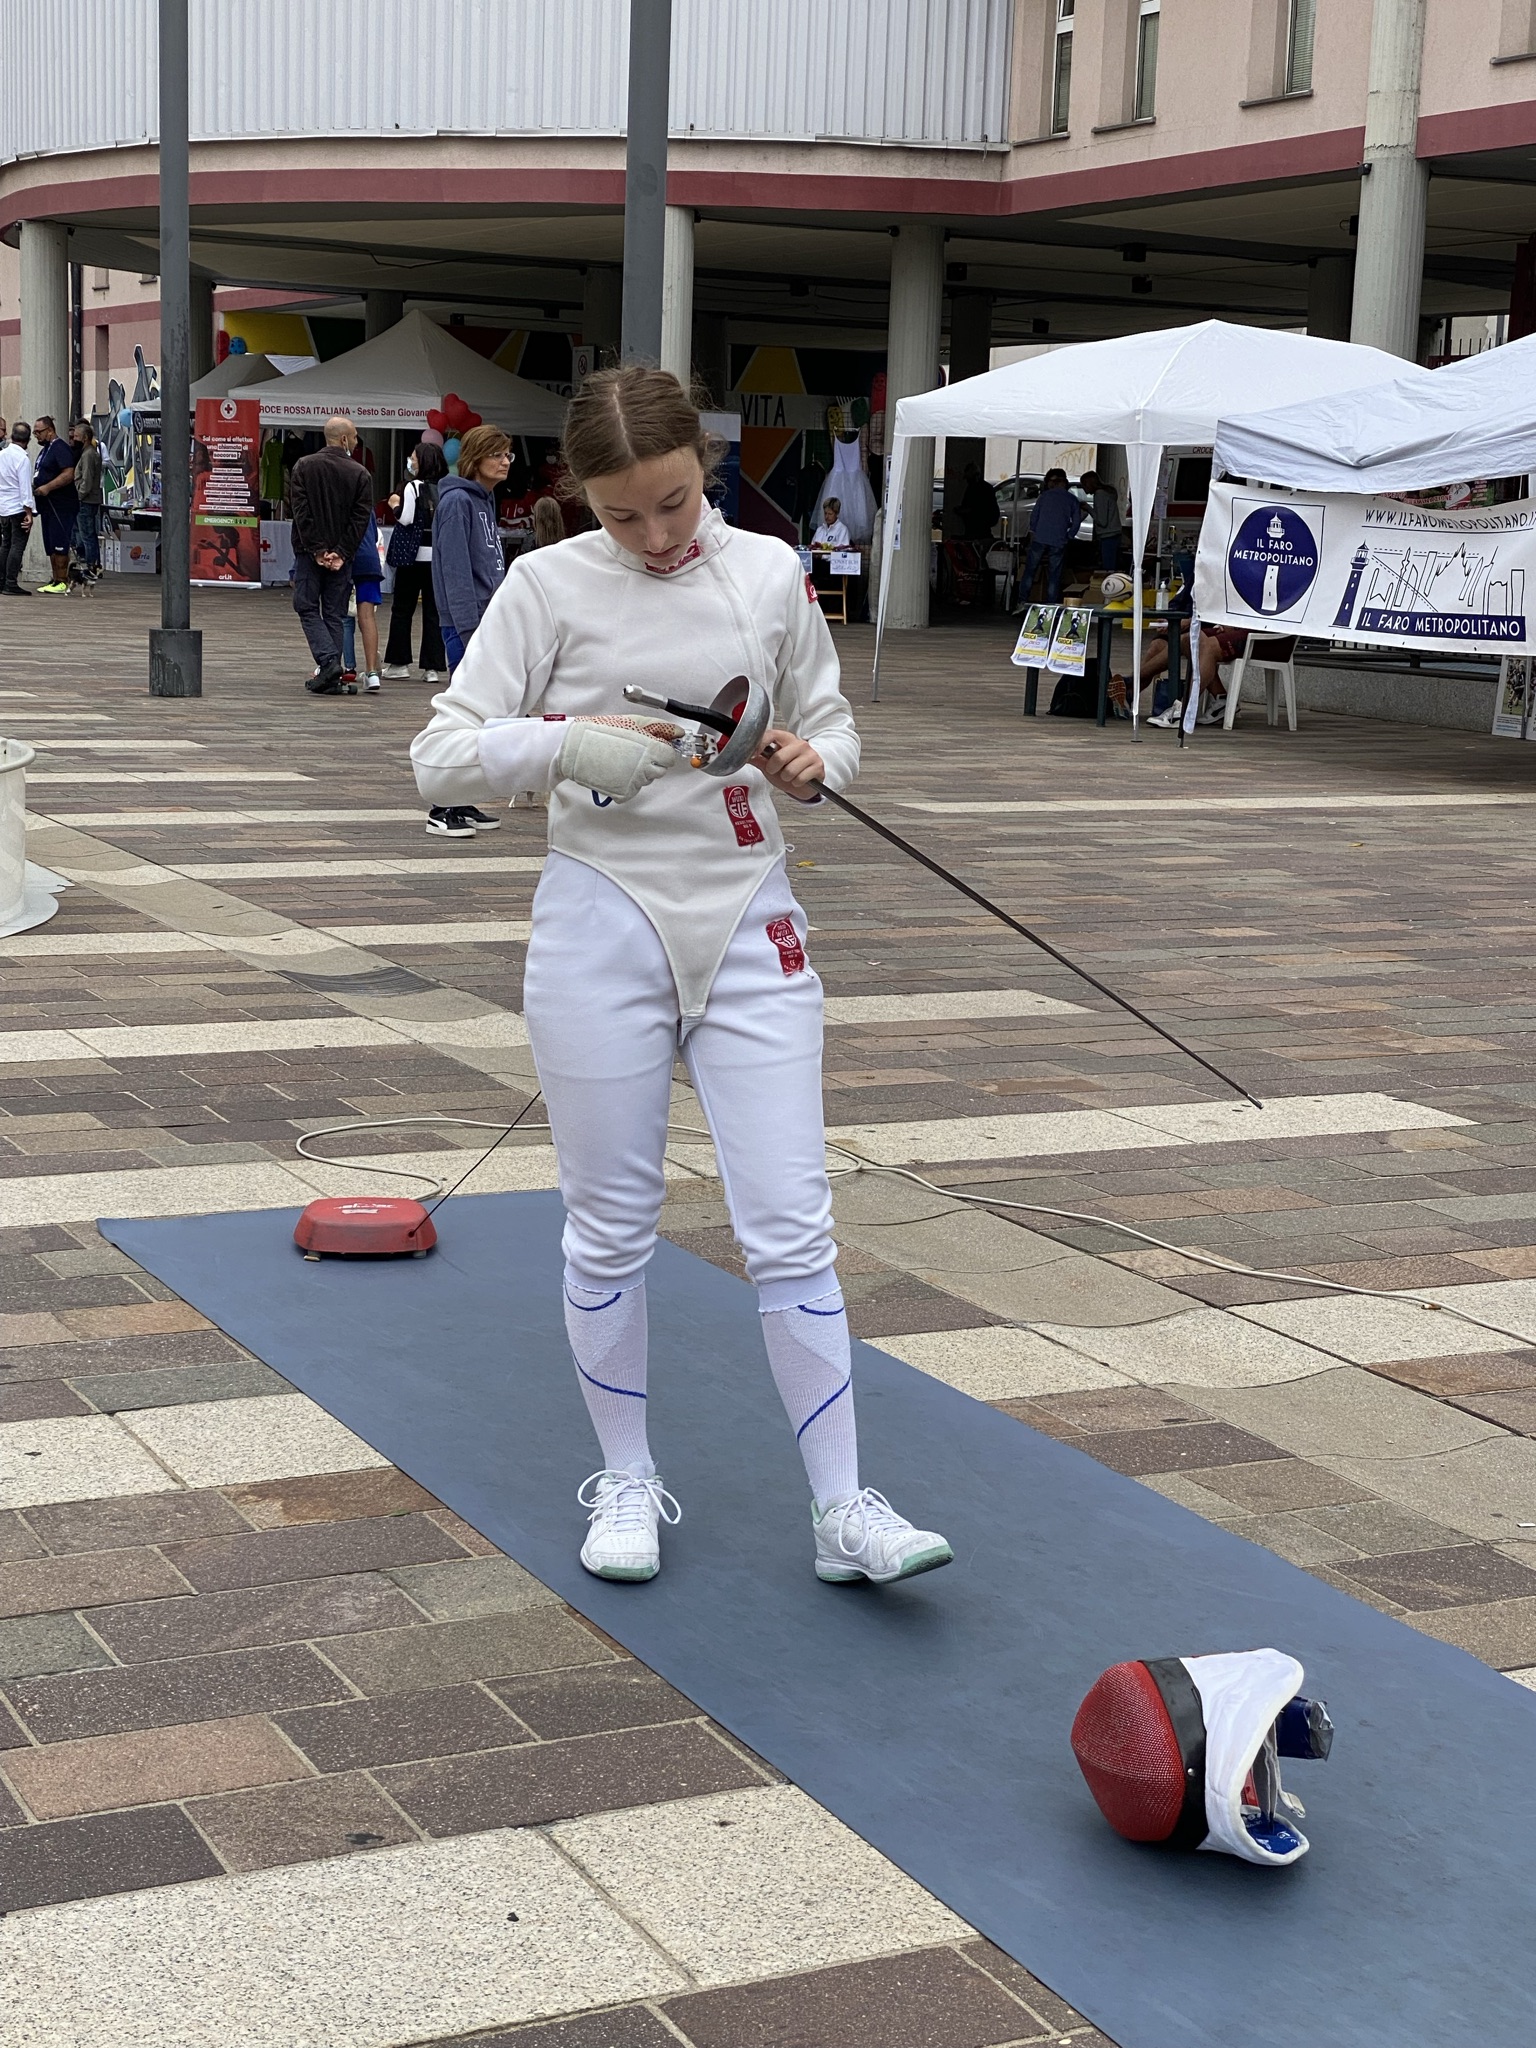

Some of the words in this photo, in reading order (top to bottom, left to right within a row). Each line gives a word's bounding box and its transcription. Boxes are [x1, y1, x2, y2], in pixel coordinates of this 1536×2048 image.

[259, 404, 282, 415] ROCE
[283, 405, 312, 415] ROSSA
[313, 406, 351, 416] ITALIANA
[357, 406, 380, 416] Sesto
[380, 407, 396, 417] San
[397, 407, 429, 418] Giovann
[740, 393, 787, 428] VITA
[1256, 538, 1265, 549] IL
[1268, 539, 1294, 551] FARO
[1233, 549, 1314, 567] METROPOLITANO
[1360, 612, 1371, 627] IL
[1377, 613, 1411, 631] FARO
[1414, 617, 1521, 637] METROPOLITANO
